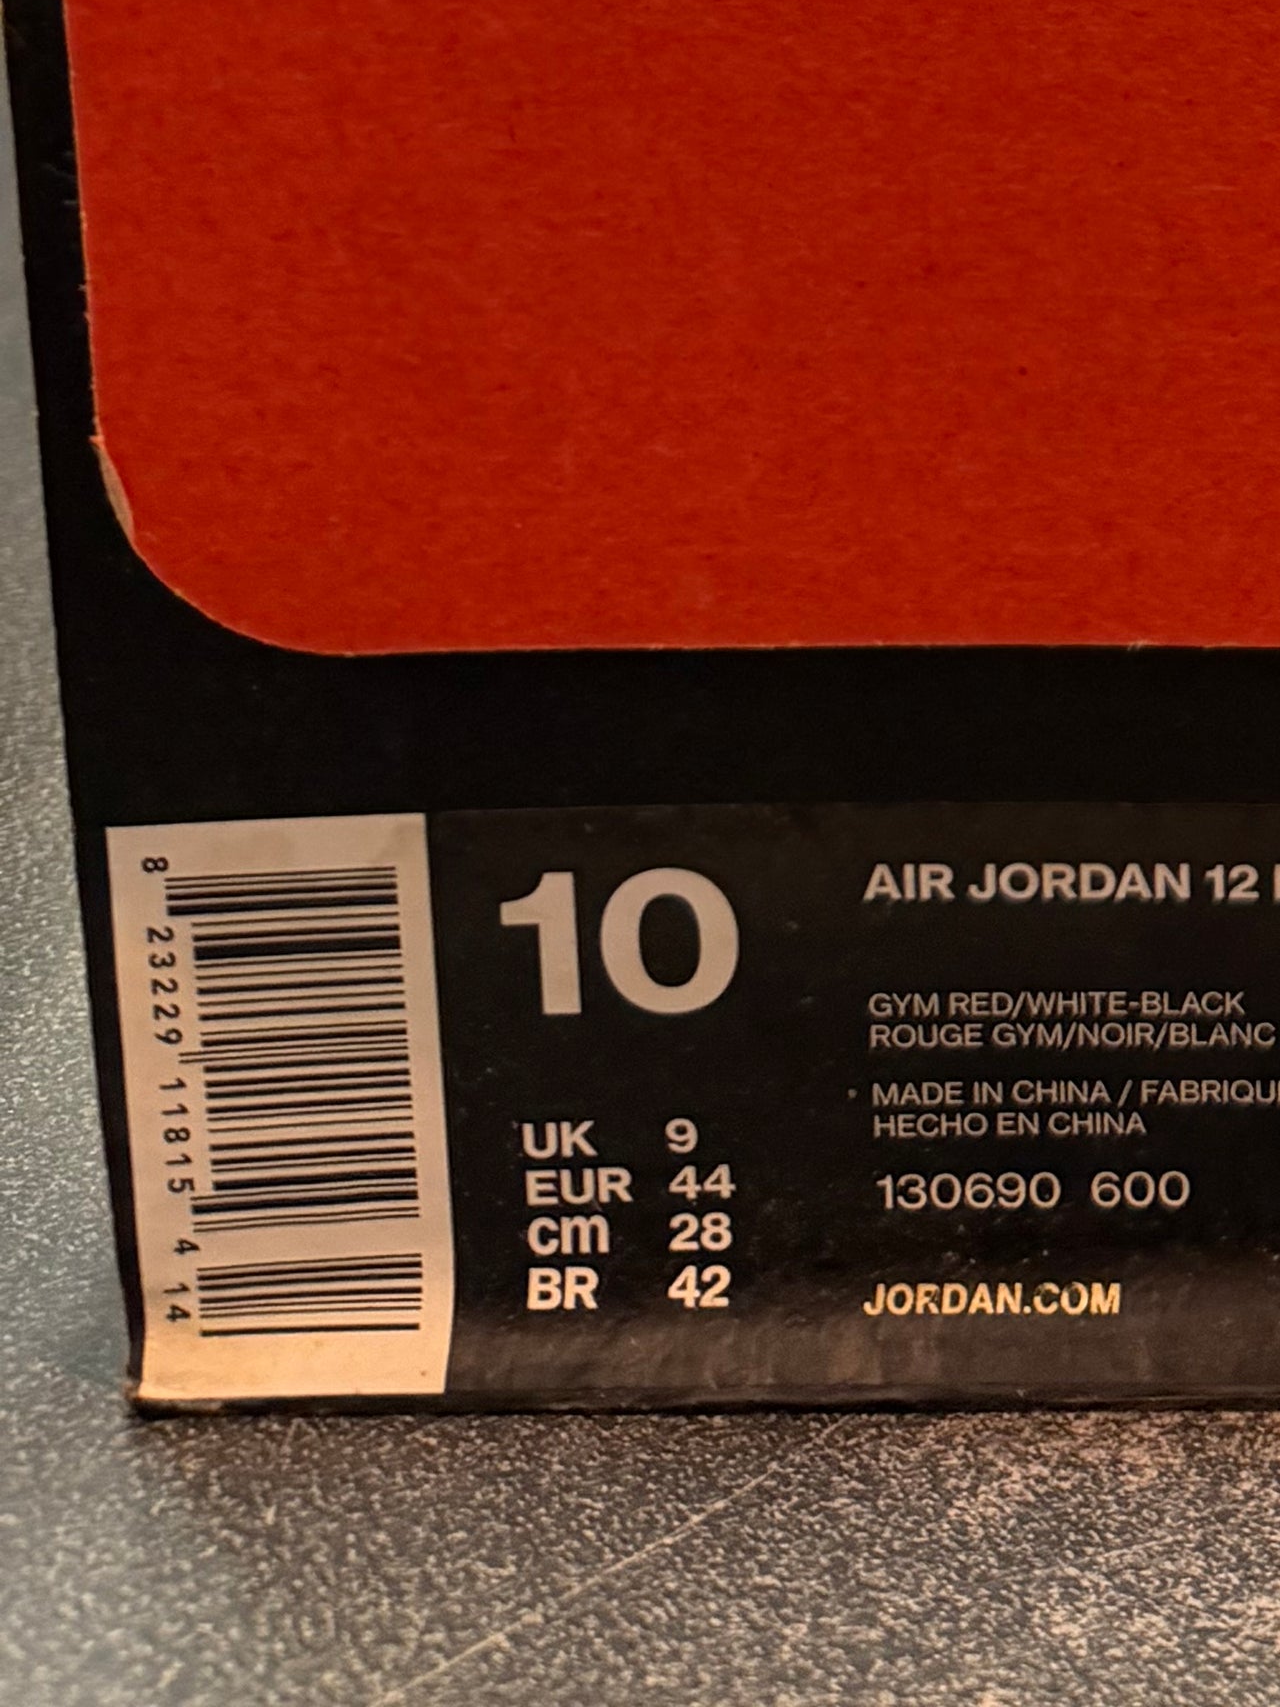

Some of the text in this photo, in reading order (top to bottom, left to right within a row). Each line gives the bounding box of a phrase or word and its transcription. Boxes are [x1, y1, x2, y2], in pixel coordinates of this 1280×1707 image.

[862, 863, 955, 903] AIR
[967, 862, 1191, 903] JORDAN
[1204, 864, 1260, 903] 12
[499, 867, 740, 1015] 10
[867, 990, 1246, 1019] GYM RED/WHITE-BLACK
[869, 1022, 1276, 1051] ROUGE GYM/NOIR/BLANC
[141, 856, 200, 1322] 8 23229 11815 4 14
[871, 1081, 965, 1105] MADE
[972, 1081, 1004, 1103] IN
[1012, 1080, 1113, 1103] CHINA
[1116, 1080, 1134, 1108] /
[522, 1118, 698, 1159] UK 9
[873, 1111, 1147, 1137] HECHO EN CHINA
[525, 1164, 737, 1206] EUR 44
[876, 1170, 1191, 1210] 130690 600
[668, 1212, 732, 1252] 28
[527, 1265, 732, 1310] BR 42
[863, 1282, 1121, 1315] JORDAN.COM
